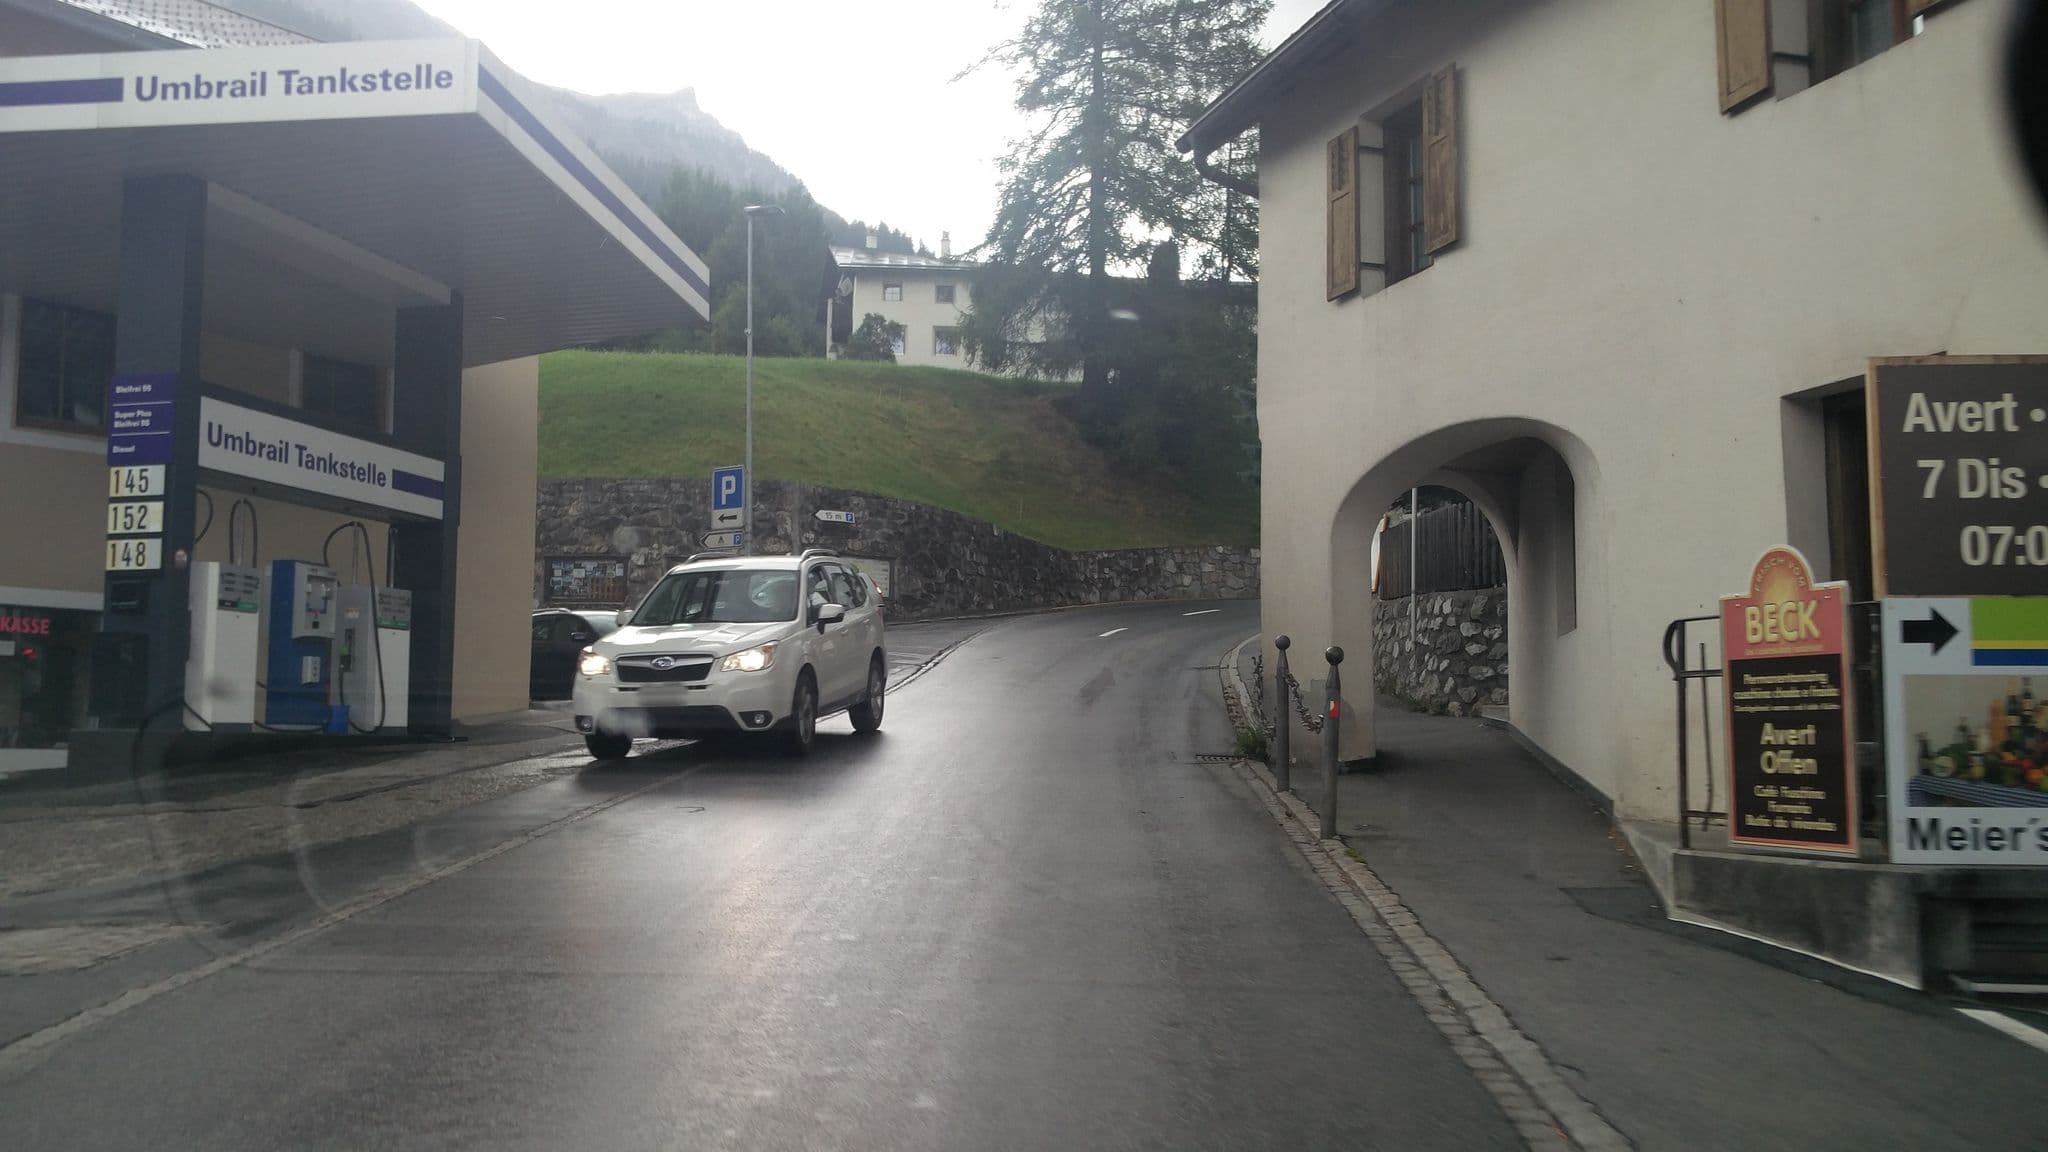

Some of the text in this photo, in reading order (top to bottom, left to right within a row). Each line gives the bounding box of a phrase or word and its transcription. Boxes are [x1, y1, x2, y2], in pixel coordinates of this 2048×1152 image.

[135, 63, 454, 102] Umbrail Tankstelle
[1902, 392, 2020, 433] Avert
[207, 421, 387, 488] Umbrail Tankstelle
[114, 468, 149, 494] 145
[721, 475, 736, 505] P
[1916, 457, 2028, 499] 7 Dis
[112, 505, 148, 531] 152
[110, 542, 146, 568] 148
[0, 615, 49, 635] KASSE
[1744, 599, 1820, 643] BECK
[1760, 722, 1817, 746] Avert
[1760, 750, 1818, 775] Offen
